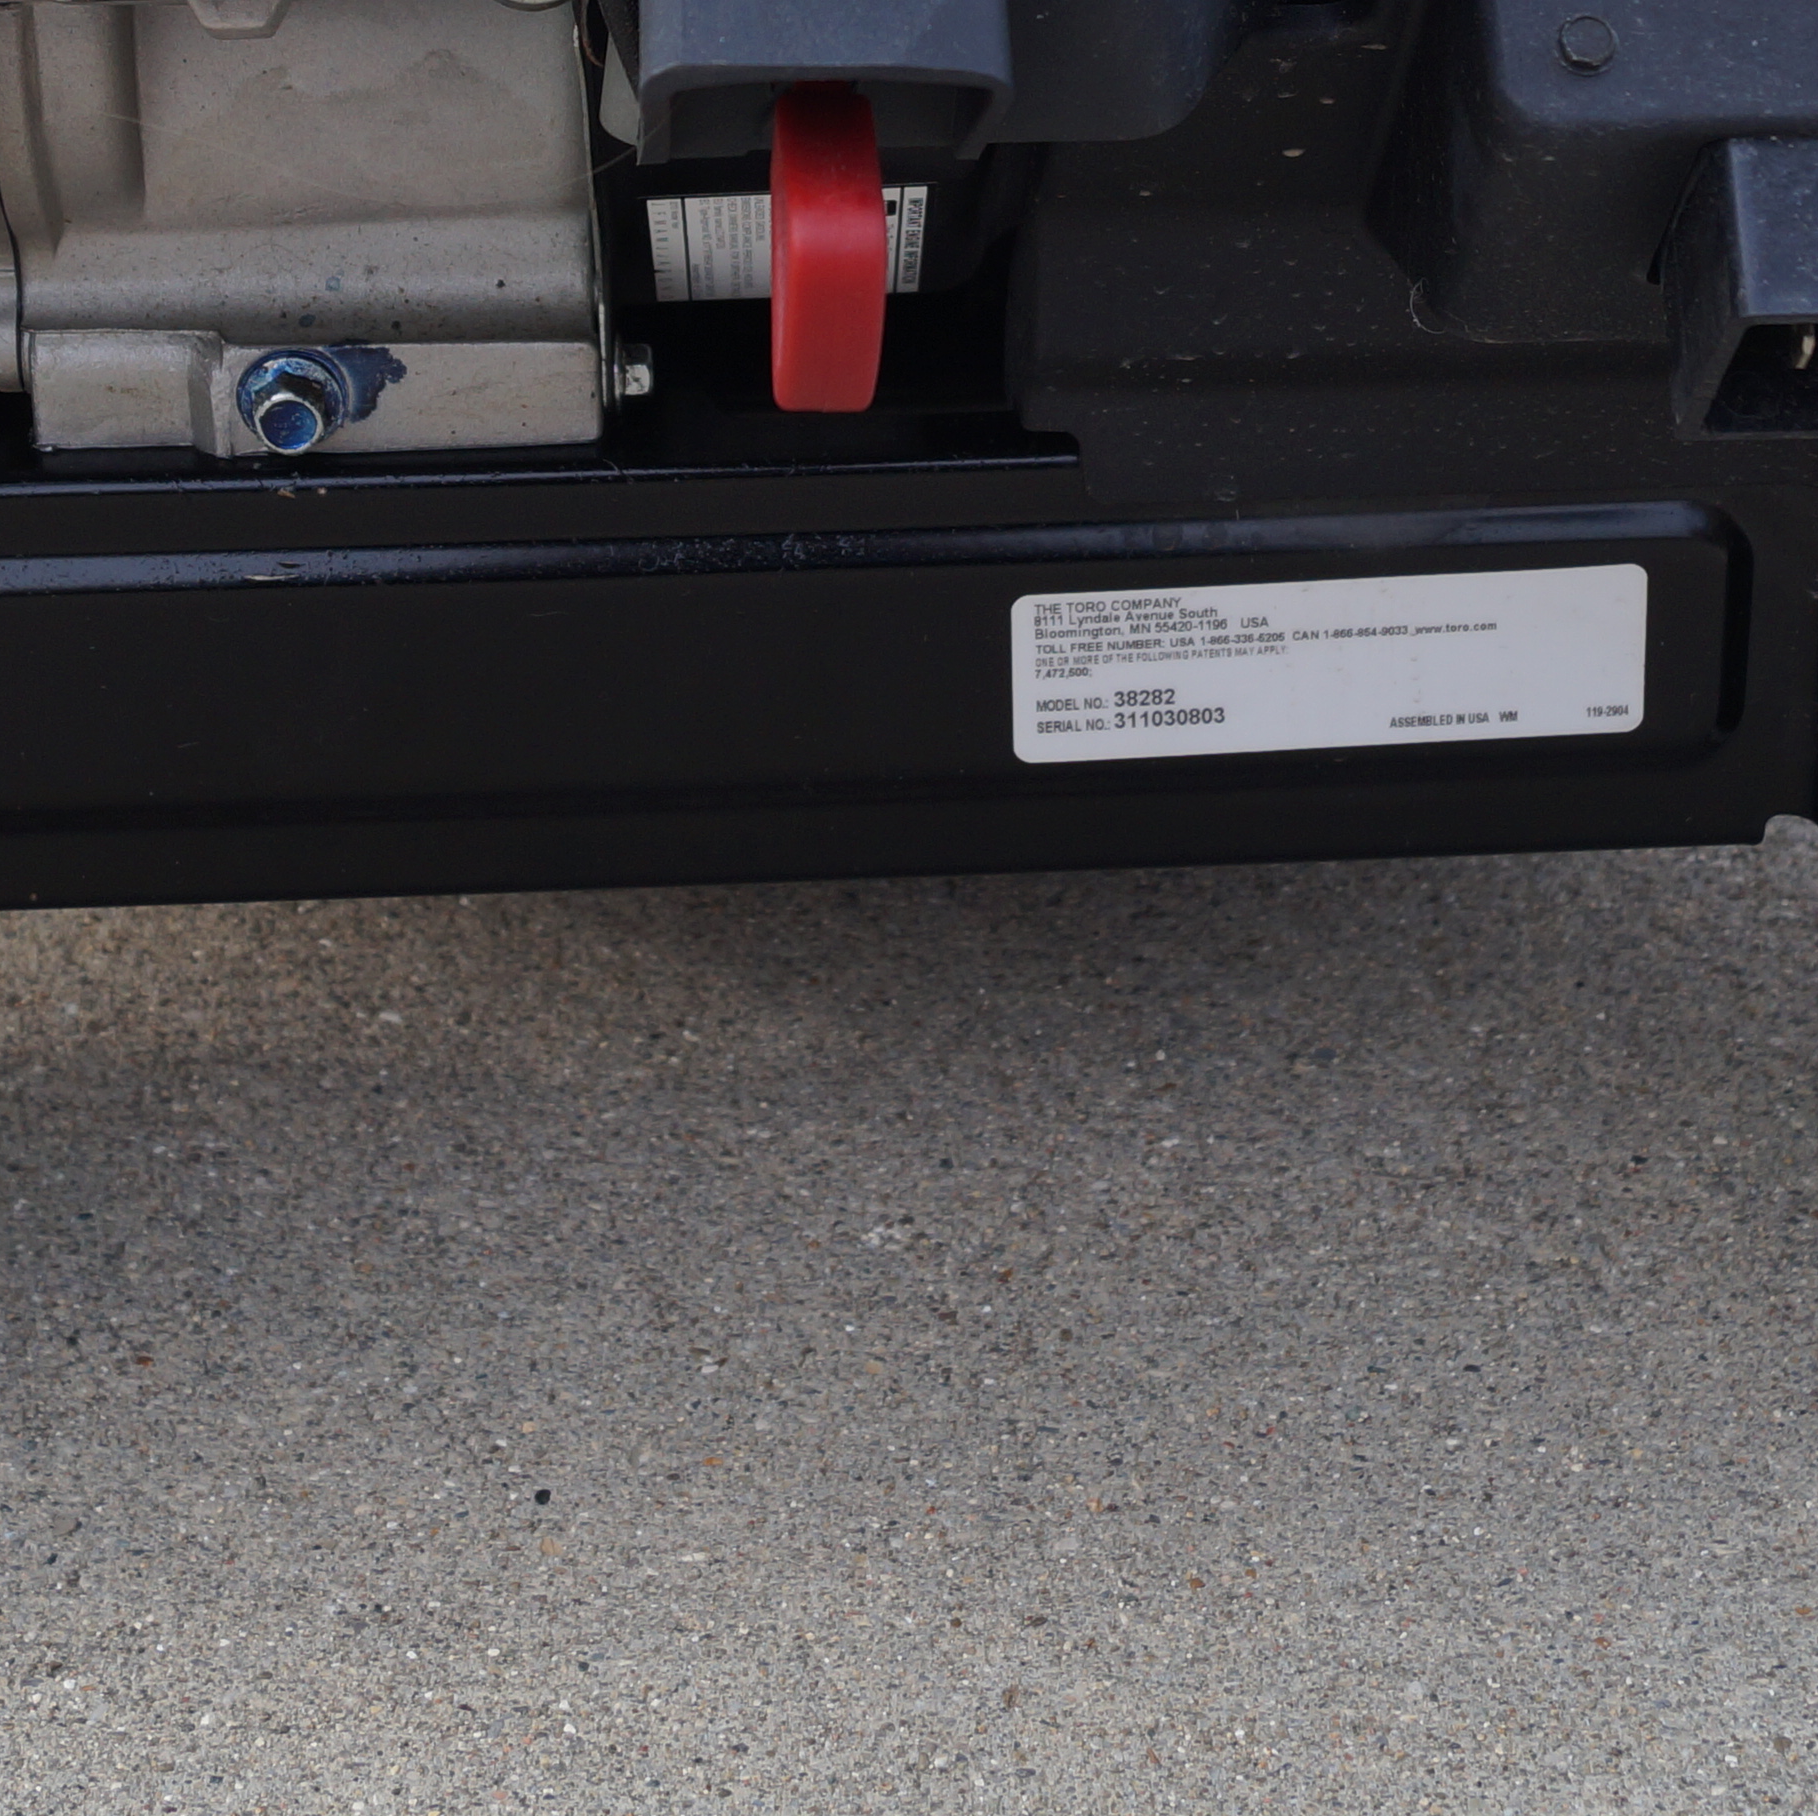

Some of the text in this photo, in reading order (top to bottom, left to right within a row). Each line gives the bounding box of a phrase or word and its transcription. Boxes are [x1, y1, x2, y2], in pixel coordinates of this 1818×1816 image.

[1034, 597, 1182, 616] THE TORO COMPANY
[1034, 607, 1218, 628] 8111 Lyndale Avenue South
[1035, 616, 1269, 641] Bloomington, MN 55420-1196 USA
[1035, 643, 1066, 655] TOLL
[1070, 641, 1103, 653] FREE
[1107, 638, 1165, 652] NUMBER:
[1169, 637, 1195, 648] USA
[1292, 629, 1319, 641] CAN
[1323, 625, 1409, 640] 1-866-854-9033
[1035, 656, 1054, 668] ONE
[1057, 655, 1070, 666] OR
[1073, 654, 1099, 665] MORE
[1102, 653, 1113, 664] OF
[1116, 652, 1134, 664] THE
[1136, 649, 1189, 663] FOLLOWING
[1191, 647, 1232, 659] PATENTS
[1234, 646, 1254, 657] MAY
[1036, 698, 1079, 712] MODEL
[1114, 688, 1176, 708] 38282
[1037, 720, 1081, 734] SERIAL
[1114, 706, 1226, 729] 311030803
[1389, 704, 1629, 729] ASSEMBLED IN USA WM 119-2904
